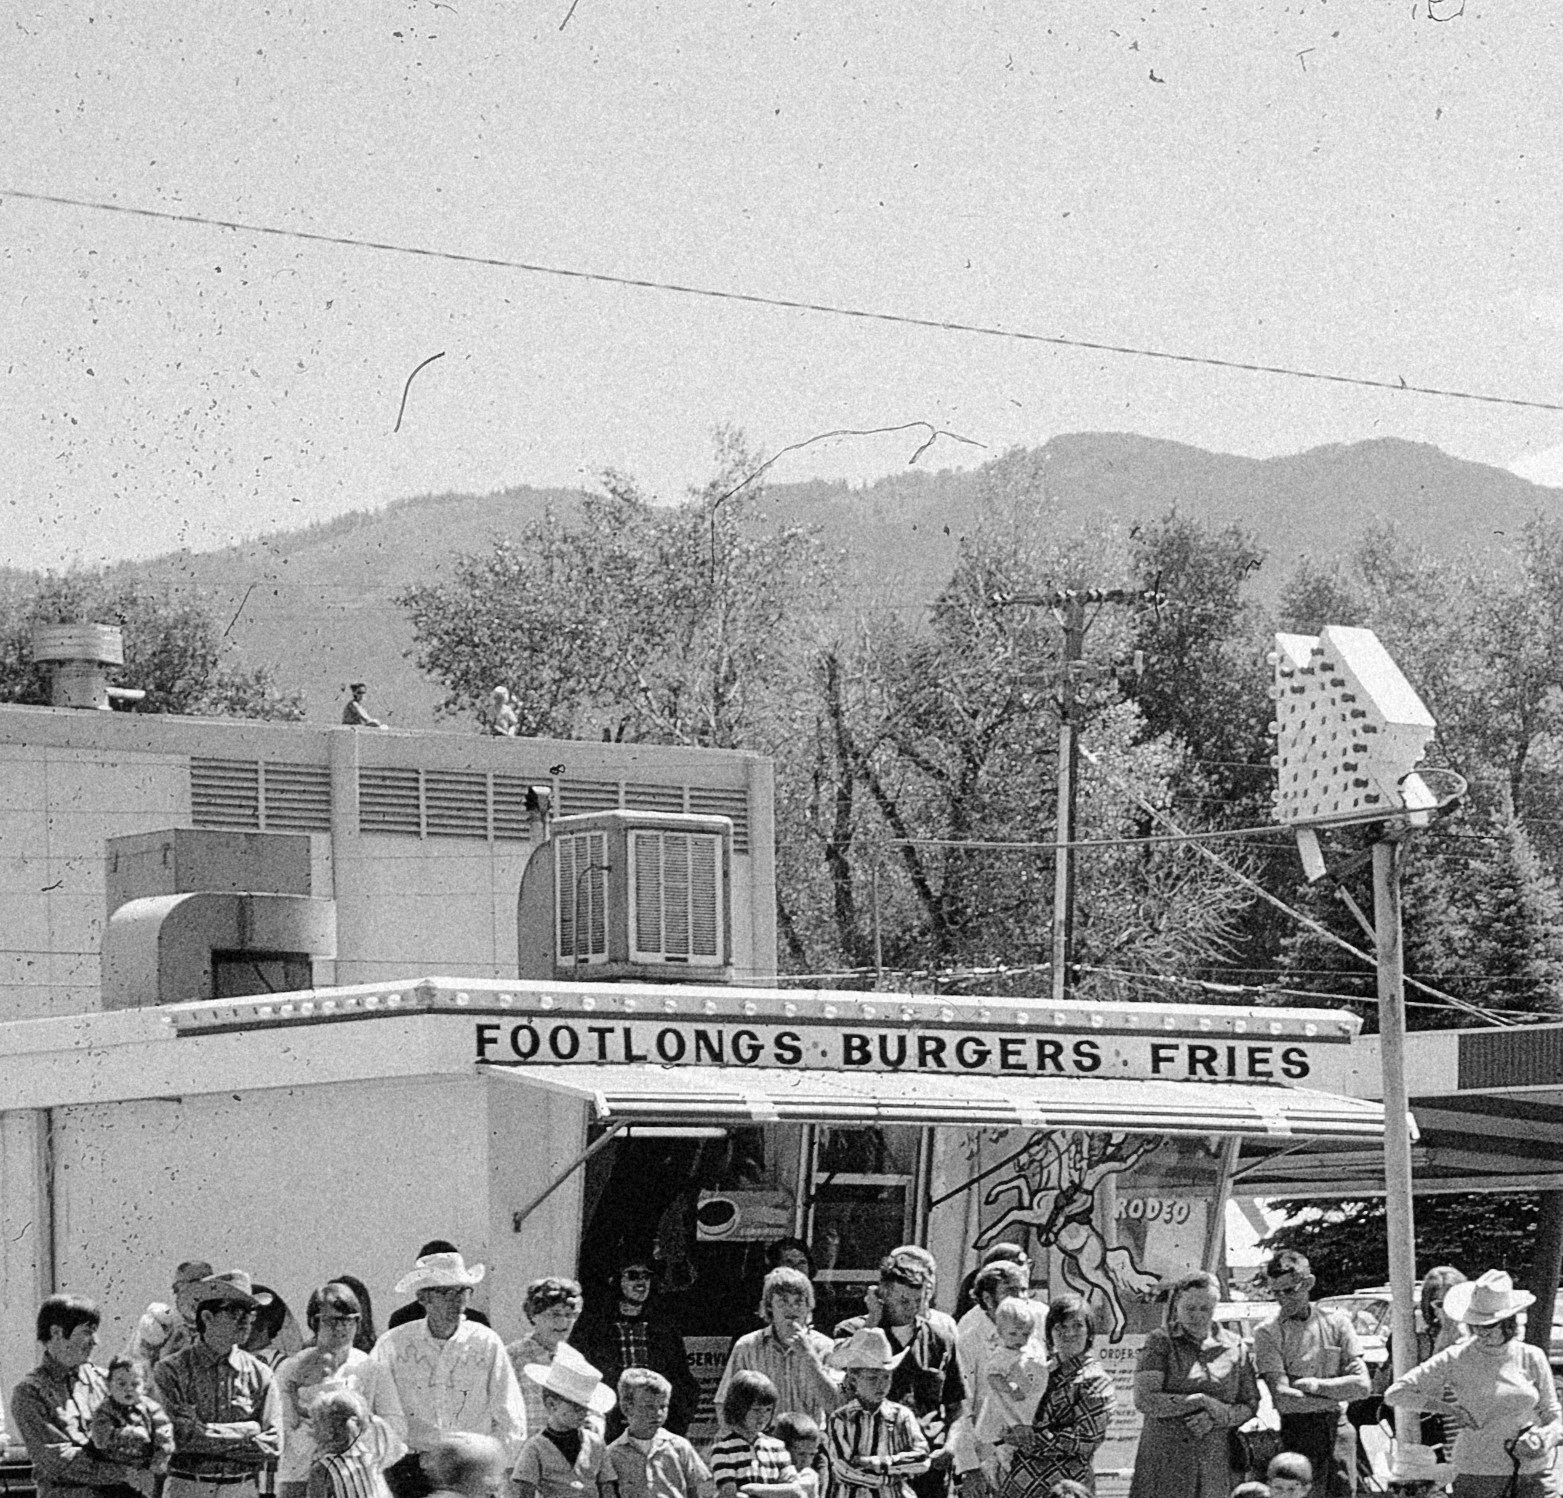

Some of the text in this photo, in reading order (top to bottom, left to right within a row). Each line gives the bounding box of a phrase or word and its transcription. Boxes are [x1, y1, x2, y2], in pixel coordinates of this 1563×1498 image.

[476, 1023, 1311, 1079] FOOTLONGS BURGERS FRIES
[1115, 1197, 1191, 1225] RODEO
